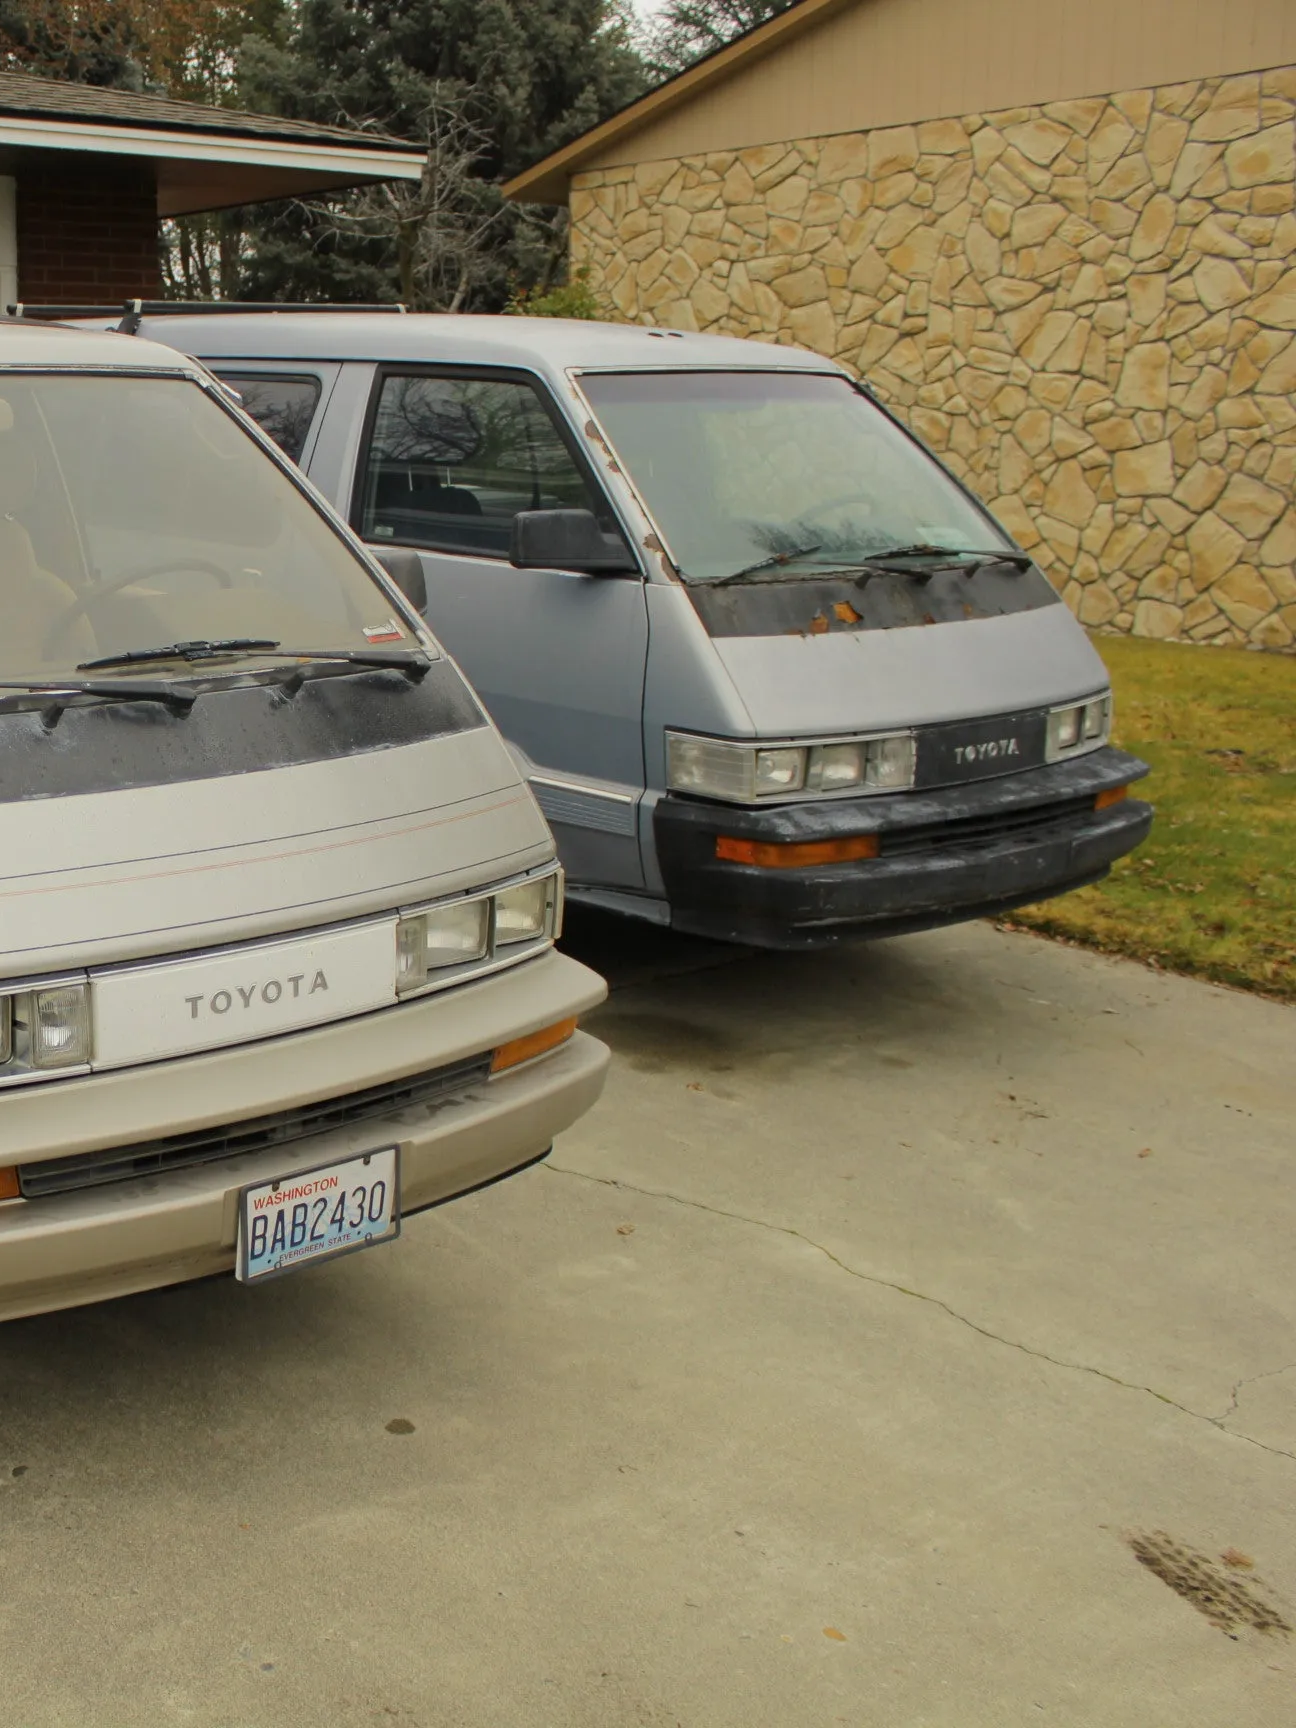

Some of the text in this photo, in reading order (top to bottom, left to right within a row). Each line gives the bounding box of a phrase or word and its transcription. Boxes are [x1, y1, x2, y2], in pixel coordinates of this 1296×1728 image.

[954, 737, 1020, 765] TOYOTA
[185, 968, 329, 1019] TOYOTA
[254, 1176, 339, 1210] WASHINGTON
[250, 1180, 386, 1261] BAB2430
[279, 1232, 352, 1262] EVERGREEN STATE
